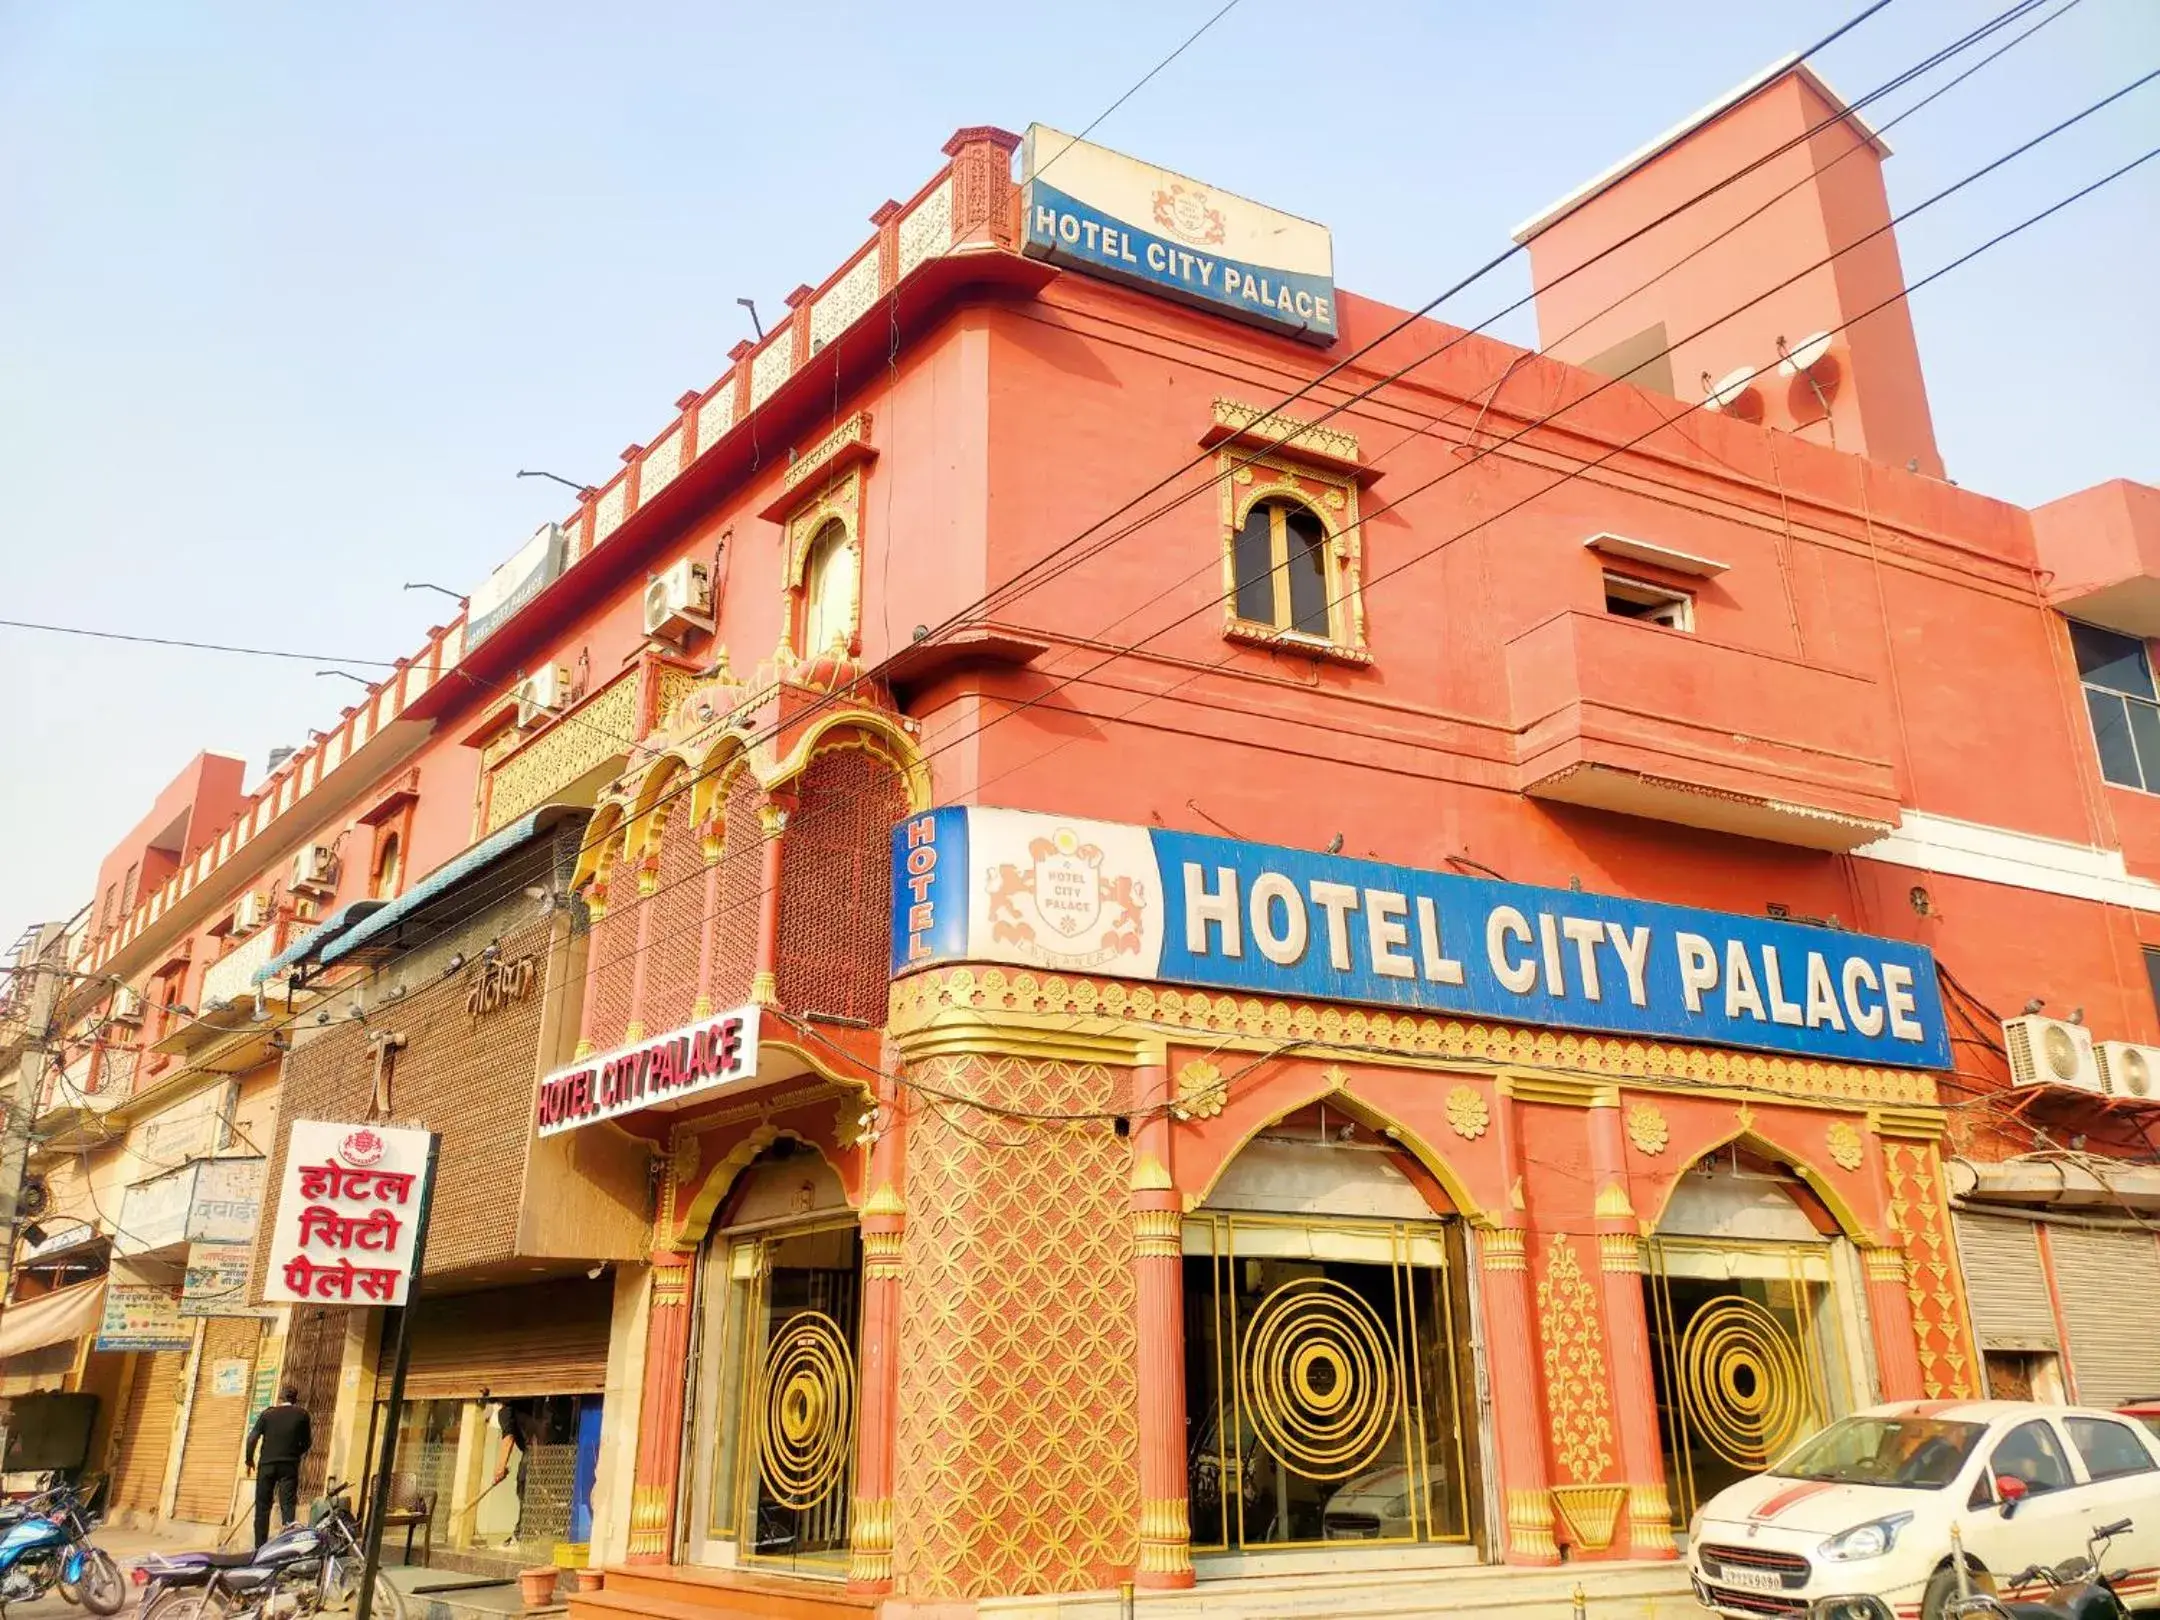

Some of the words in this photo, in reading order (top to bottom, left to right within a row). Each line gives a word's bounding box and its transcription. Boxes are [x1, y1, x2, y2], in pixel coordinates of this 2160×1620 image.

[1036, 205, 1137, 263] HOTEL
[1147, 243, 1216, 287] CITY
[1224, 267, 1330, 324] PALACE
[907, 816, 937, 961] HOTEL
[1049, 871, 1086, 885] HOTEL
[1055, 886, 1081, 897] CITY
[1046, 898, 1090, 913] PALACE
[1183, 862, 1464, 985] HOTEL
[1486, 905, 1650, 1006] CITY
[1676, 931, 1924, 1042] PALACE
[538, 1069, 599, 1127] HOTEL
[600, 1050, 648, 1107] CITY
[649, 1018, 741, 1093] PALACE
[299, 1158, 416, 1205] होटल
[298, 1205, 402, 1251] सिटी
[283, 1254, 402, 1302] पैलेस
